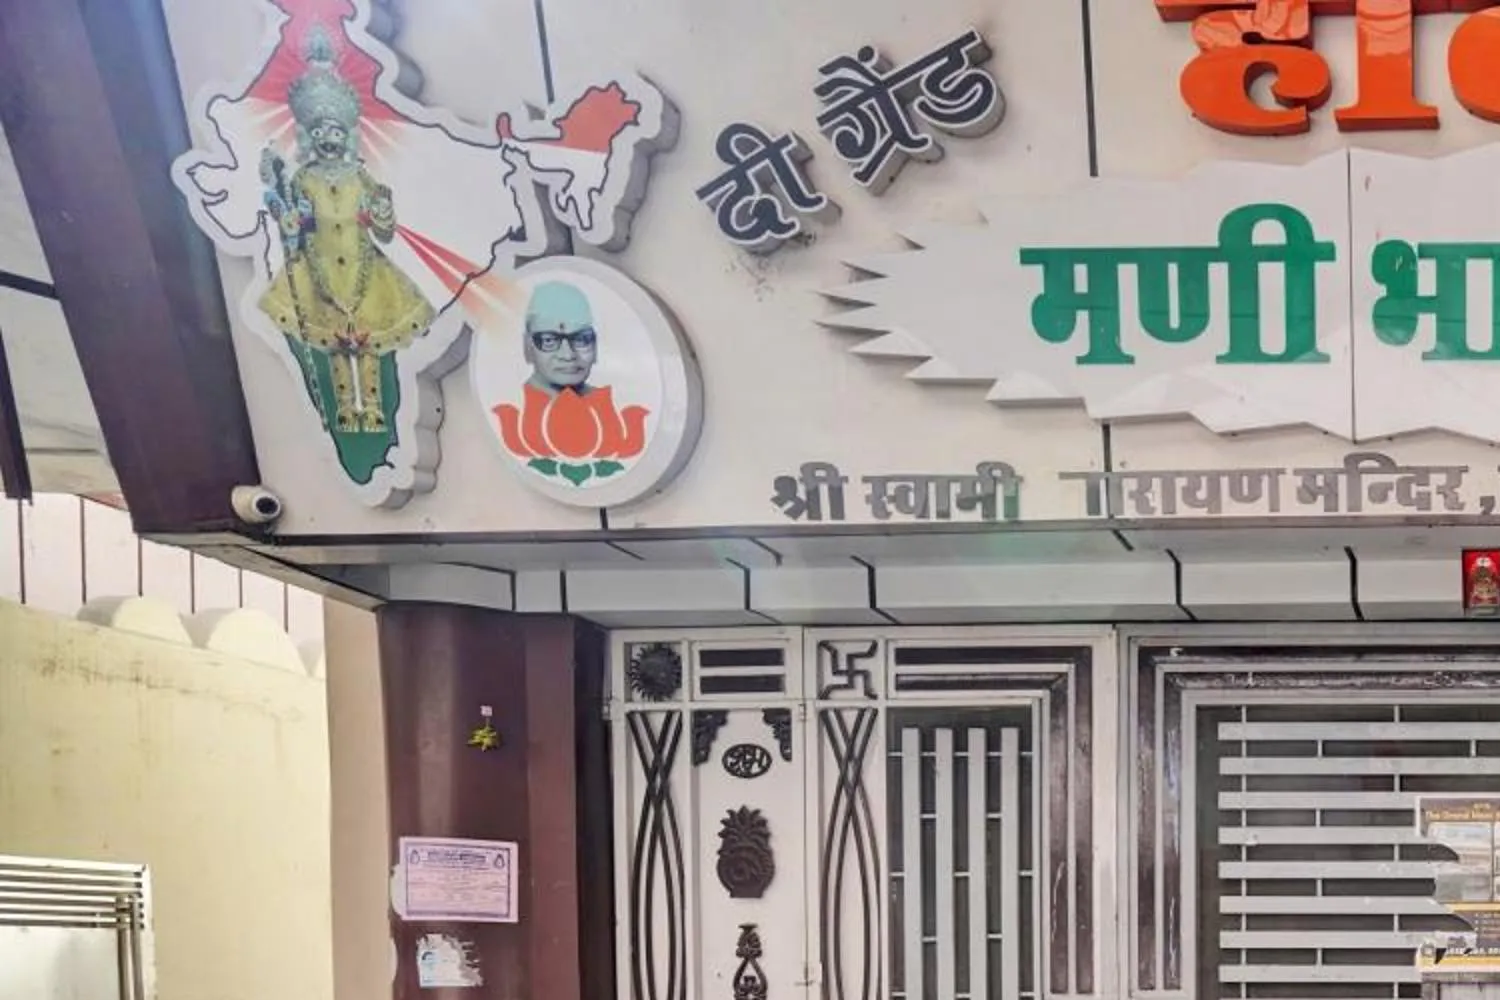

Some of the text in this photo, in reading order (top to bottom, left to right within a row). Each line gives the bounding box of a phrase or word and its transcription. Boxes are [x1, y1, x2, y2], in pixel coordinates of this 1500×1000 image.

[696, 121, 828, 245] दी
[1019, 203, 1337, 365] मणी
[770, 461, 849, 521] श्री
[862, 461, 1024, 520] स्वामी
